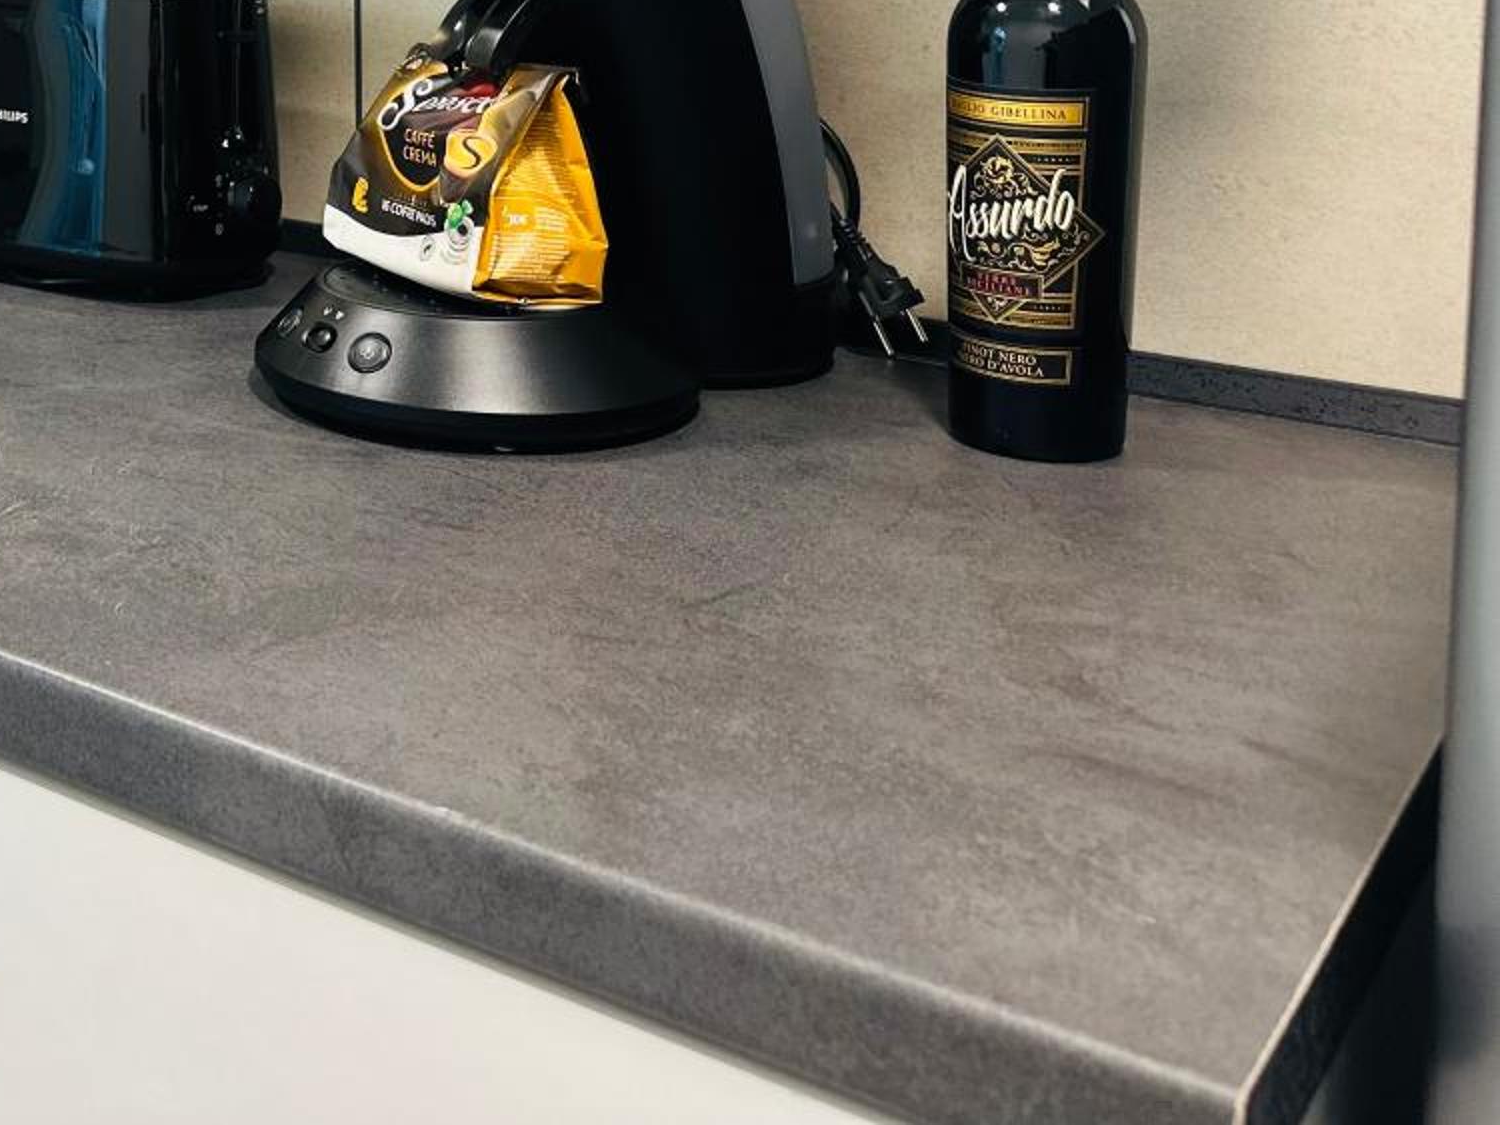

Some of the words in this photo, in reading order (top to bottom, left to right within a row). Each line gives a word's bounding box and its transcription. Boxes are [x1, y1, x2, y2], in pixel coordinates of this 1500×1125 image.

[990, 105, 1067, 120] GIBELLINA
[403, 145, 437, 168] CREMA
[948, 164, 1076, 262] Assurdo
[998, 351, 1037, 366] NERO
[987, 359, 1044, 378] D'AVOLA
